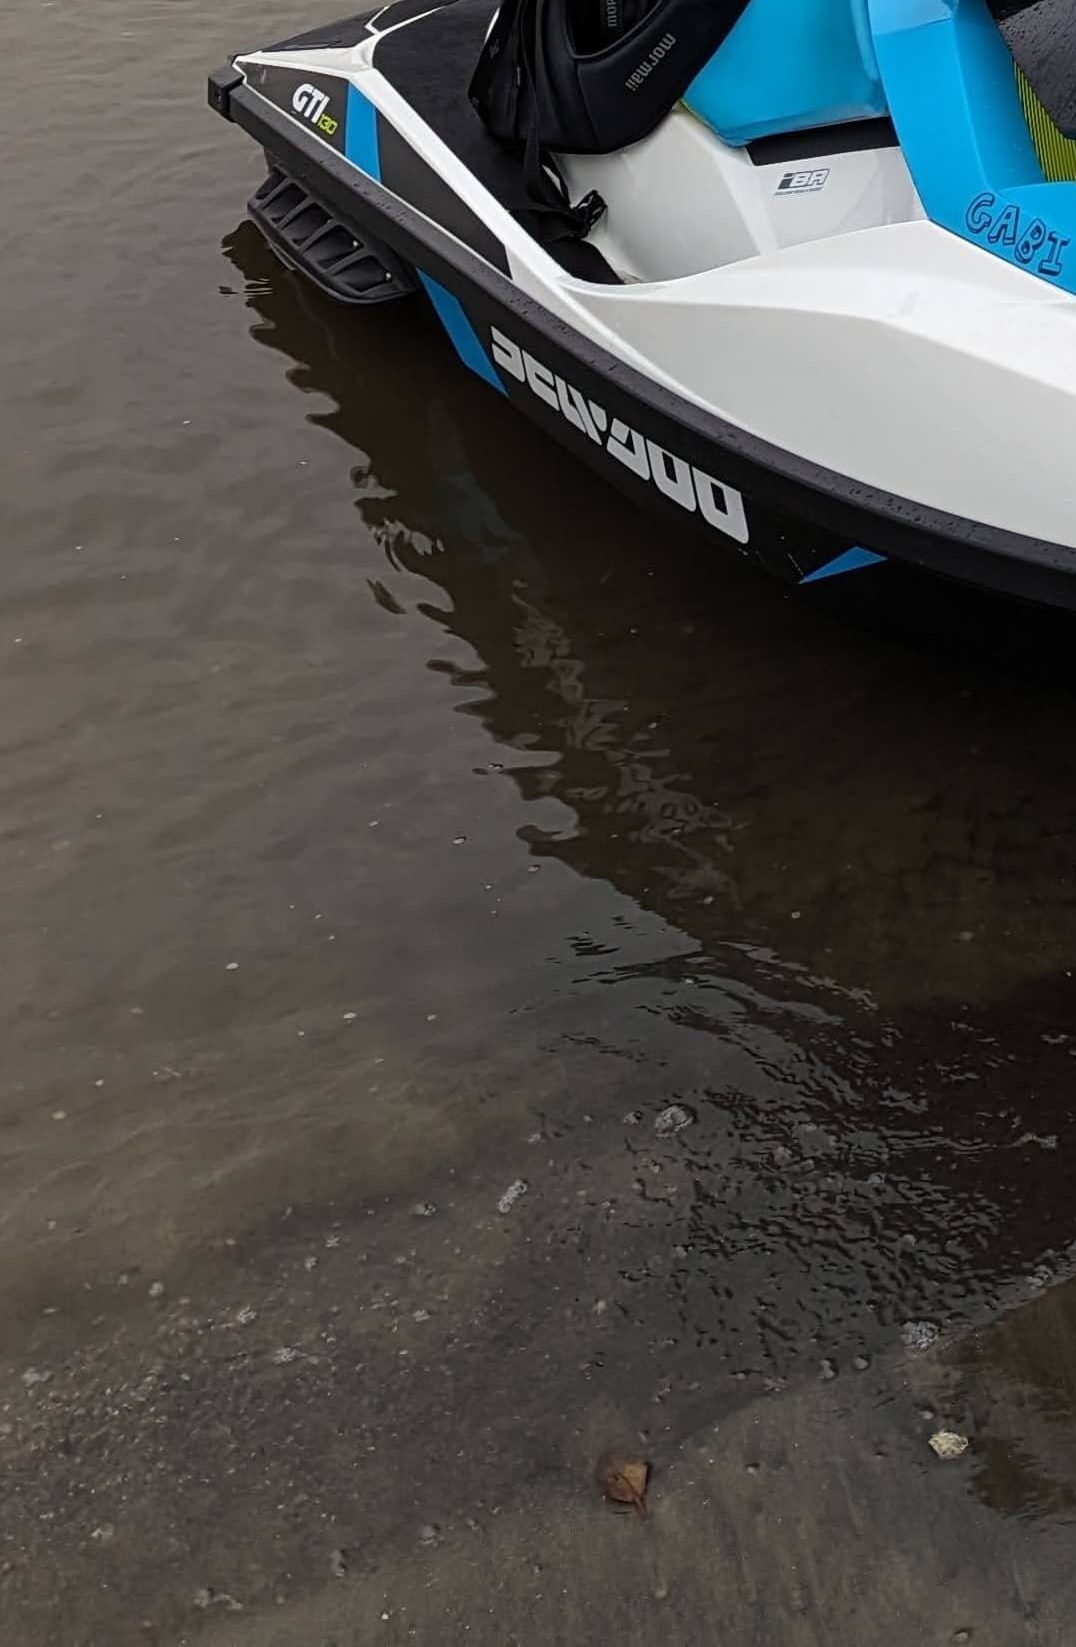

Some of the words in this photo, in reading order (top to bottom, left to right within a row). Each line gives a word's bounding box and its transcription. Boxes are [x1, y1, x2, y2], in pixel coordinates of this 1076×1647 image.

[625, 33, 677, 91] mormaii
[292, 83, 331, 124] GTI
[965, 192, 1071, 277] GABI
